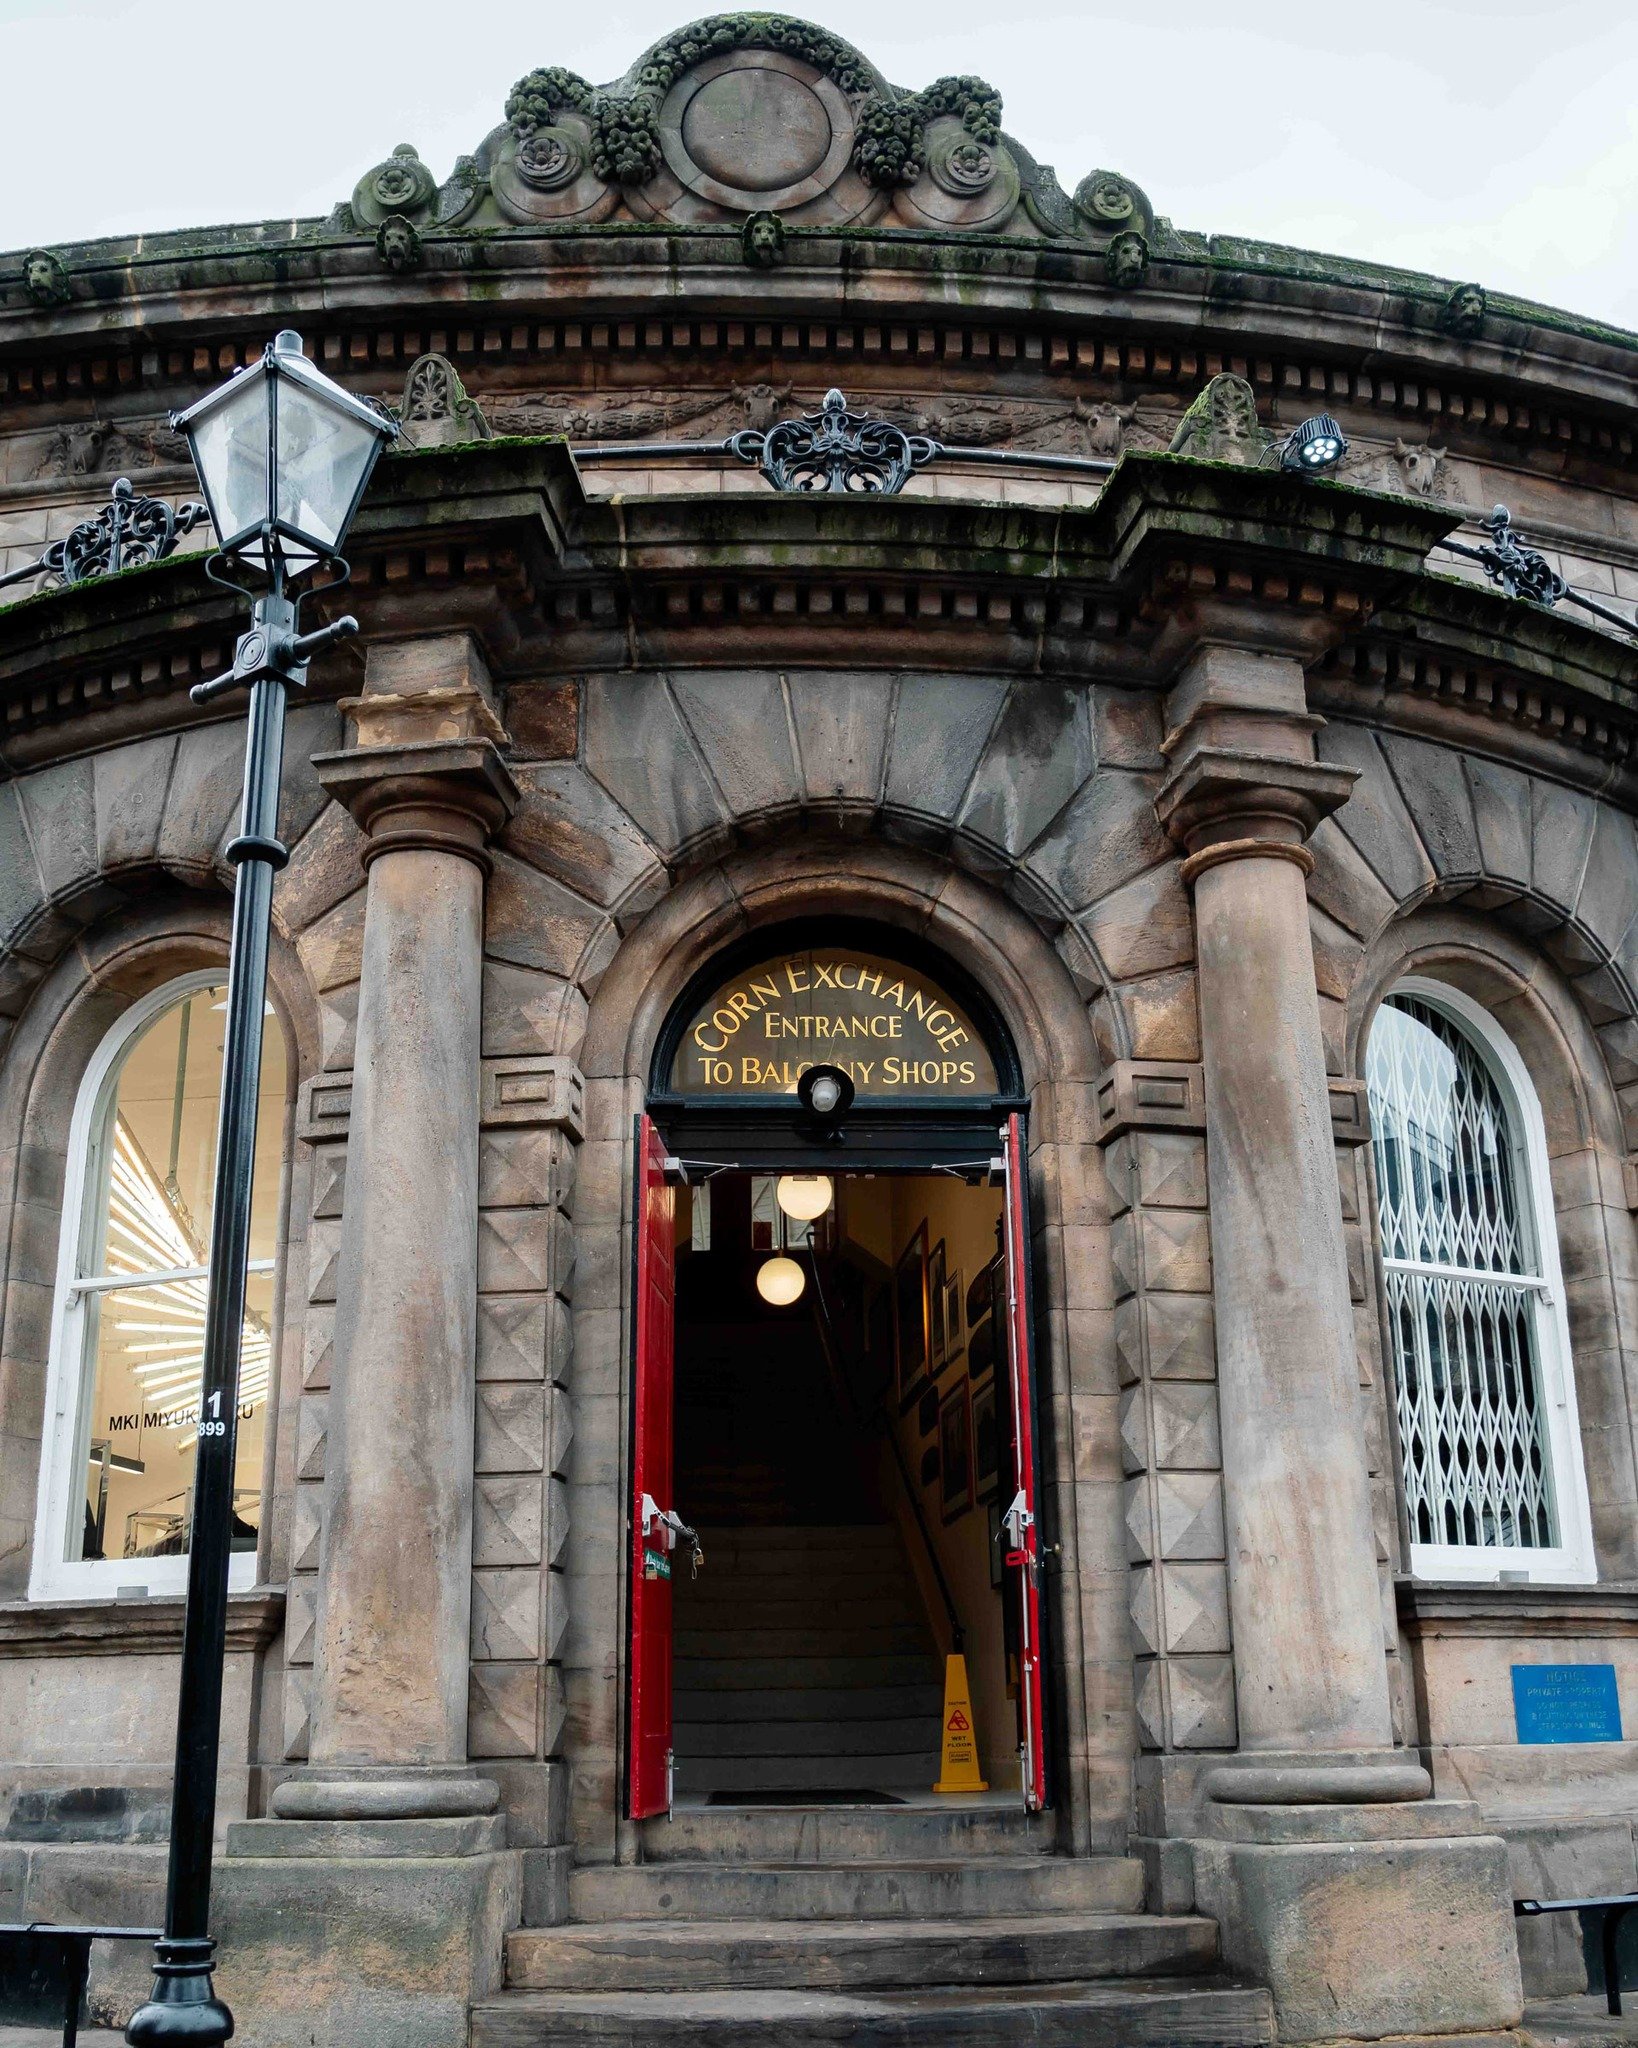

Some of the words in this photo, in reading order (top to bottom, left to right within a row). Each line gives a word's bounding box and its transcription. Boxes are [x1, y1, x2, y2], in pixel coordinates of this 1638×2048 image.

[694, 974, 782, 1052] CORN
[784, 959, 970, 1053] EXCHANGE
[764, 1012, 902, 1039] ENTRANCE
[698, 1057, 733, 1084] TO
[882, 1056, 976, 1085] SHOPS
[207, 1391, 221, 1418] 1
[109, 1415, 138, 1431] MKI
[144, 1408, 200, 1428] MIYUK
